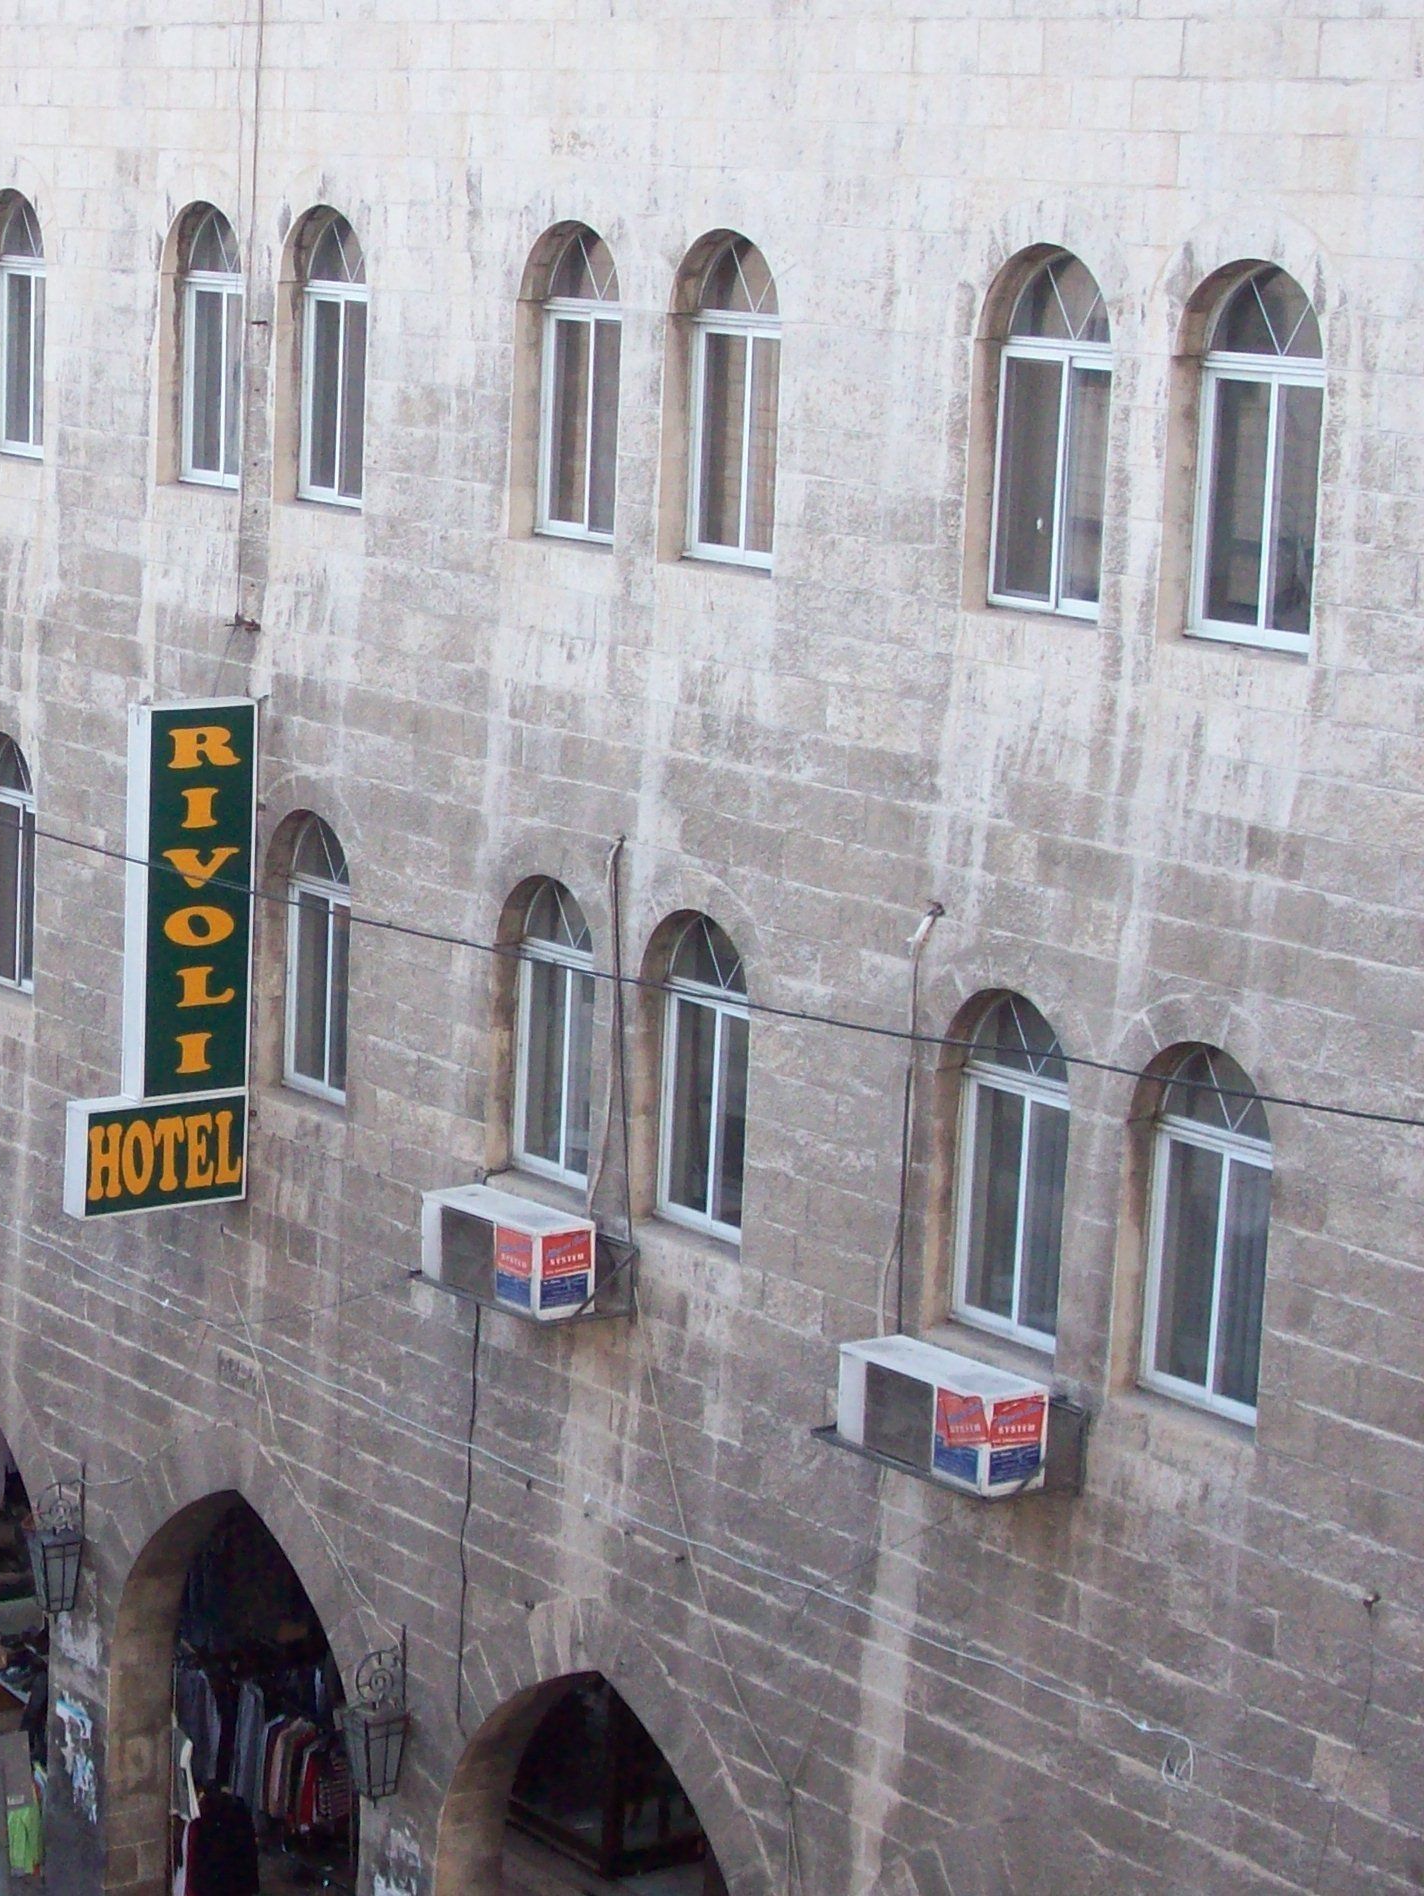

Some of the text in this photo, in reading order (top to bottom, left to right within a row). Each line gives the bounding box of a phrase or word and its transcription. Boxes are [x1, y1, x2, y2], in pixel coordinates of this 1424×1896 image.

[162, 725, 242, 1075] RIVOLI
[87, 1109, 243, 1202] HOTEL
[549, 1252, 585, 1266] SYSTEM
[997, 1423, 1036, 1435] SYSTEM
